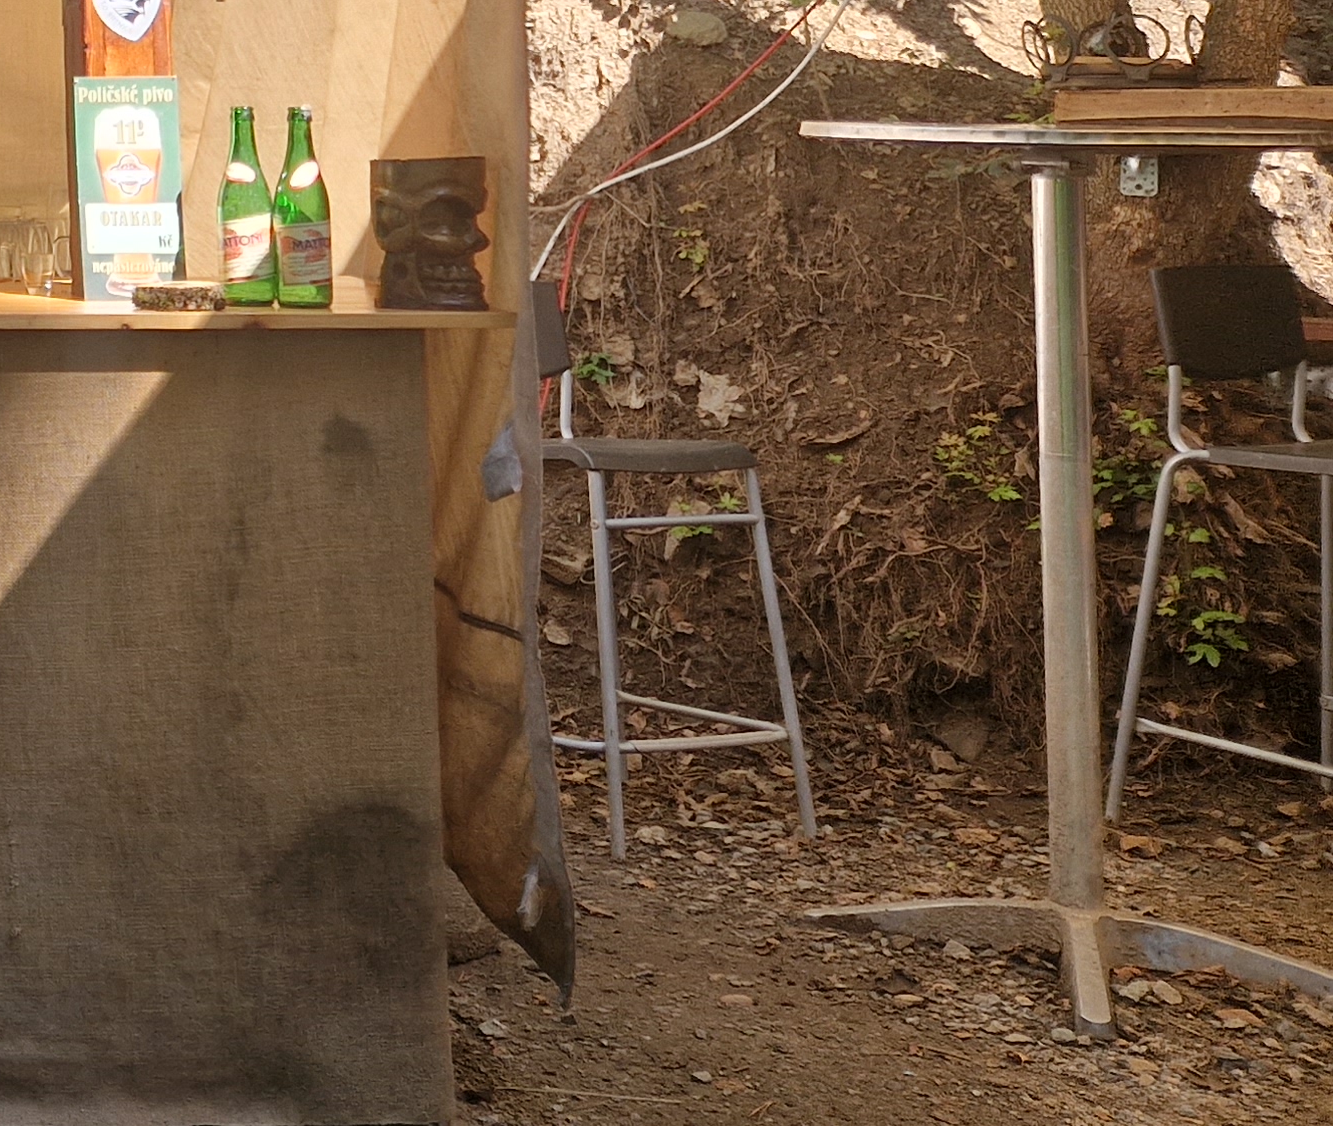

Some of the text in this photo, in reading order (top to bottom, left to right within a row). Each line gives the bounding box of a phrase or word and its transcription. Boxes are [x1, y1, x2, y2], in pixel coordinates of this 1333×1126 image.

[78, 85, 174, 105] Poličské pivo
[100, 211, 163, 226] OTAKAR
[158, 234, 173, 248] Kč
[222, 233, 264, 249] ATTONI
[292, 238, 330, 251] MATTO
